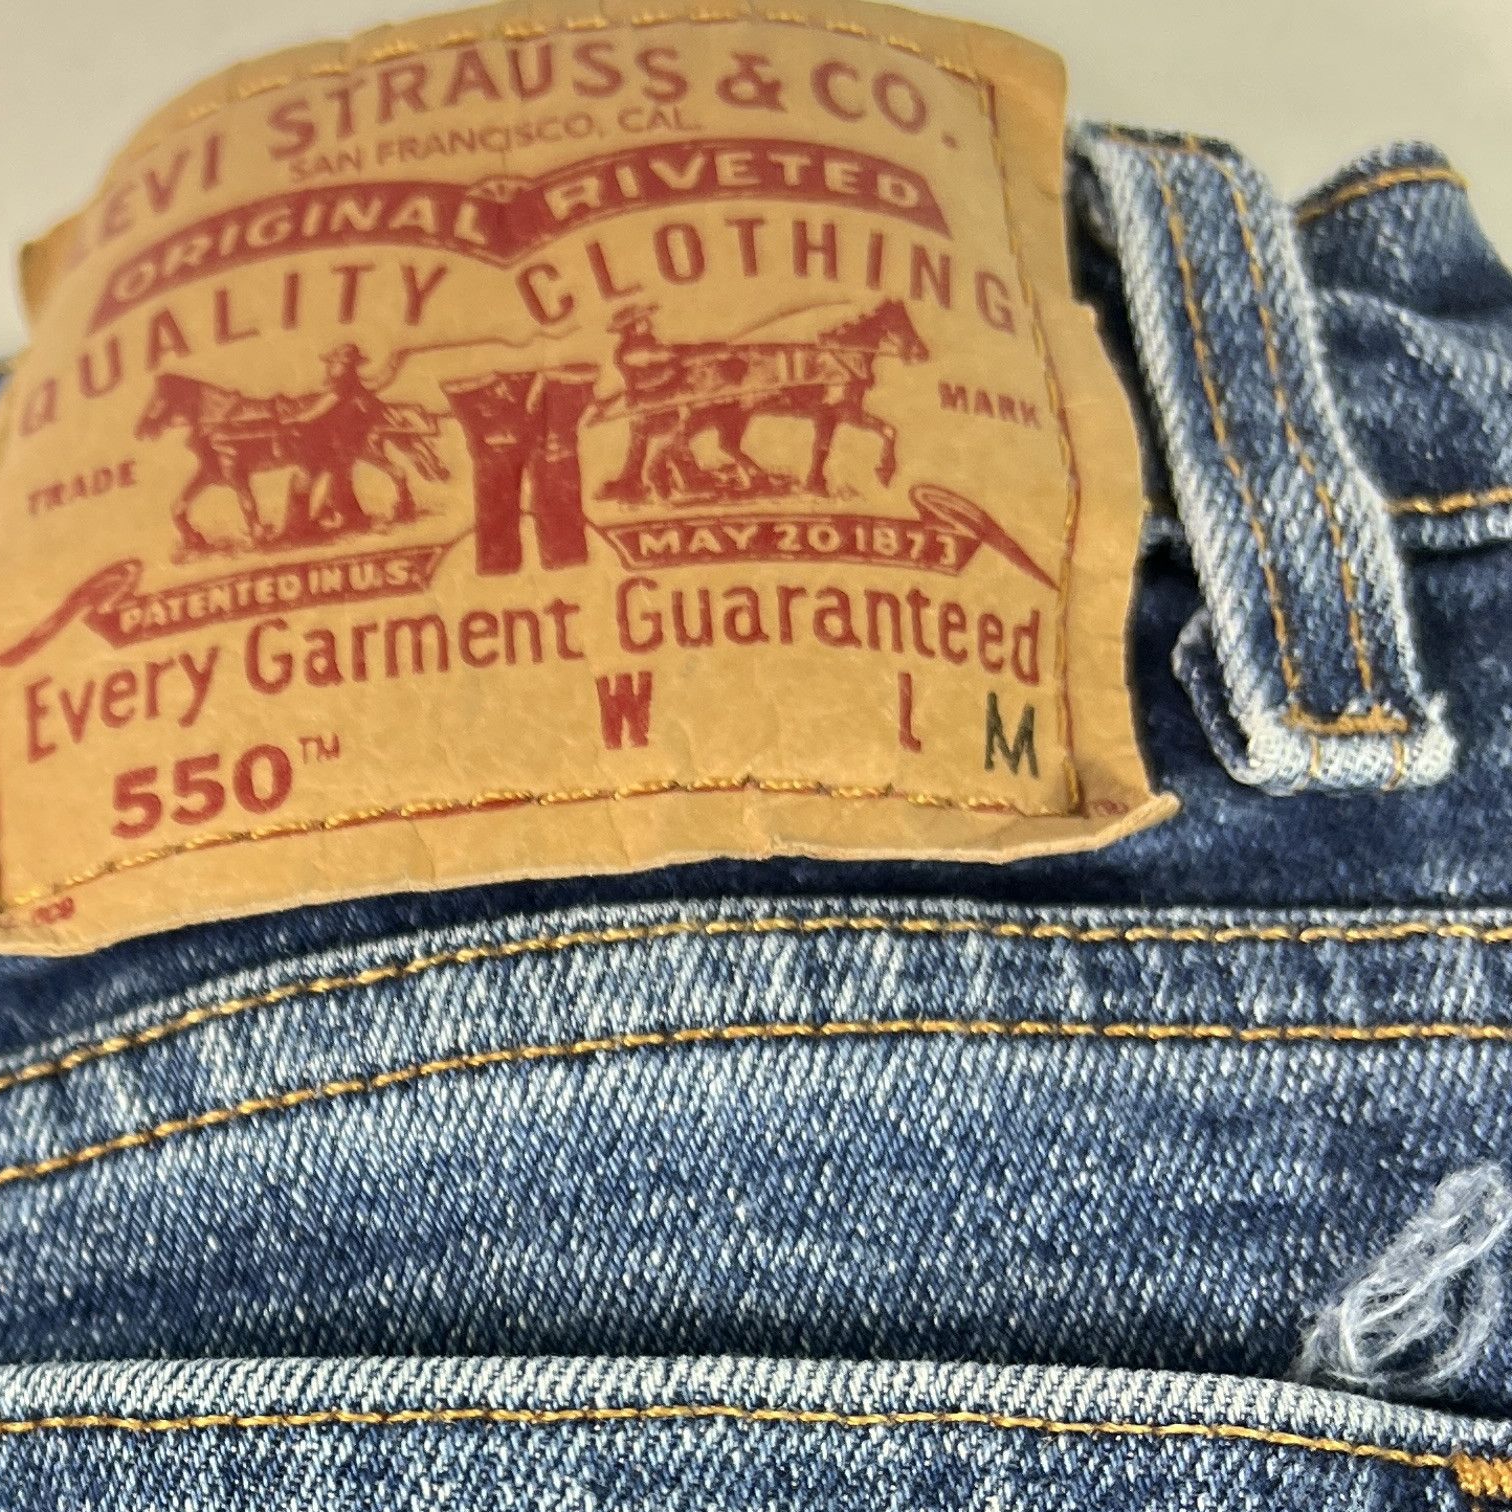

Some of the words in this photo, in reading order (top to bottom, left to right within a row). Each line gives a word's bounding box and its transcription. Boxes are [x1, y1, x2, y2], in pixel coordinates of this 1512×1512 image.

[266, 40, 689, 161] STRAUSS
[715, 51, 786, 112] &
[809, 58, 961, 150] CO.
[288, 148, 363, 182] SAN
[376, 107, 606, 170] FRANCISCO,
[616, 103, 702, 133] CAL.
[110, 195, 488, 304] ORIGINAL
[543, 150, 922, 219] RIVETED
[19, 262, 450, 438] QUALITY
[514, 216, 1017, 335] CLOTHING
[937, 379, 1044, 429] MARK
[26, 458, 139, 514] TRADE
[637, 520, 759, 558] MAY
[774, 522, 838, 554] 20
[854, 524, 960, 567] 1873
[119, 572, 303, 634] PATENTED
[22, 644, 222, 766] Every
[243, 597, 586, 696] Garment
[614, 576, 1042, 687] Guaranteed
[595, 670, 654, 750] W
[982, 690, 1040, 779] M
